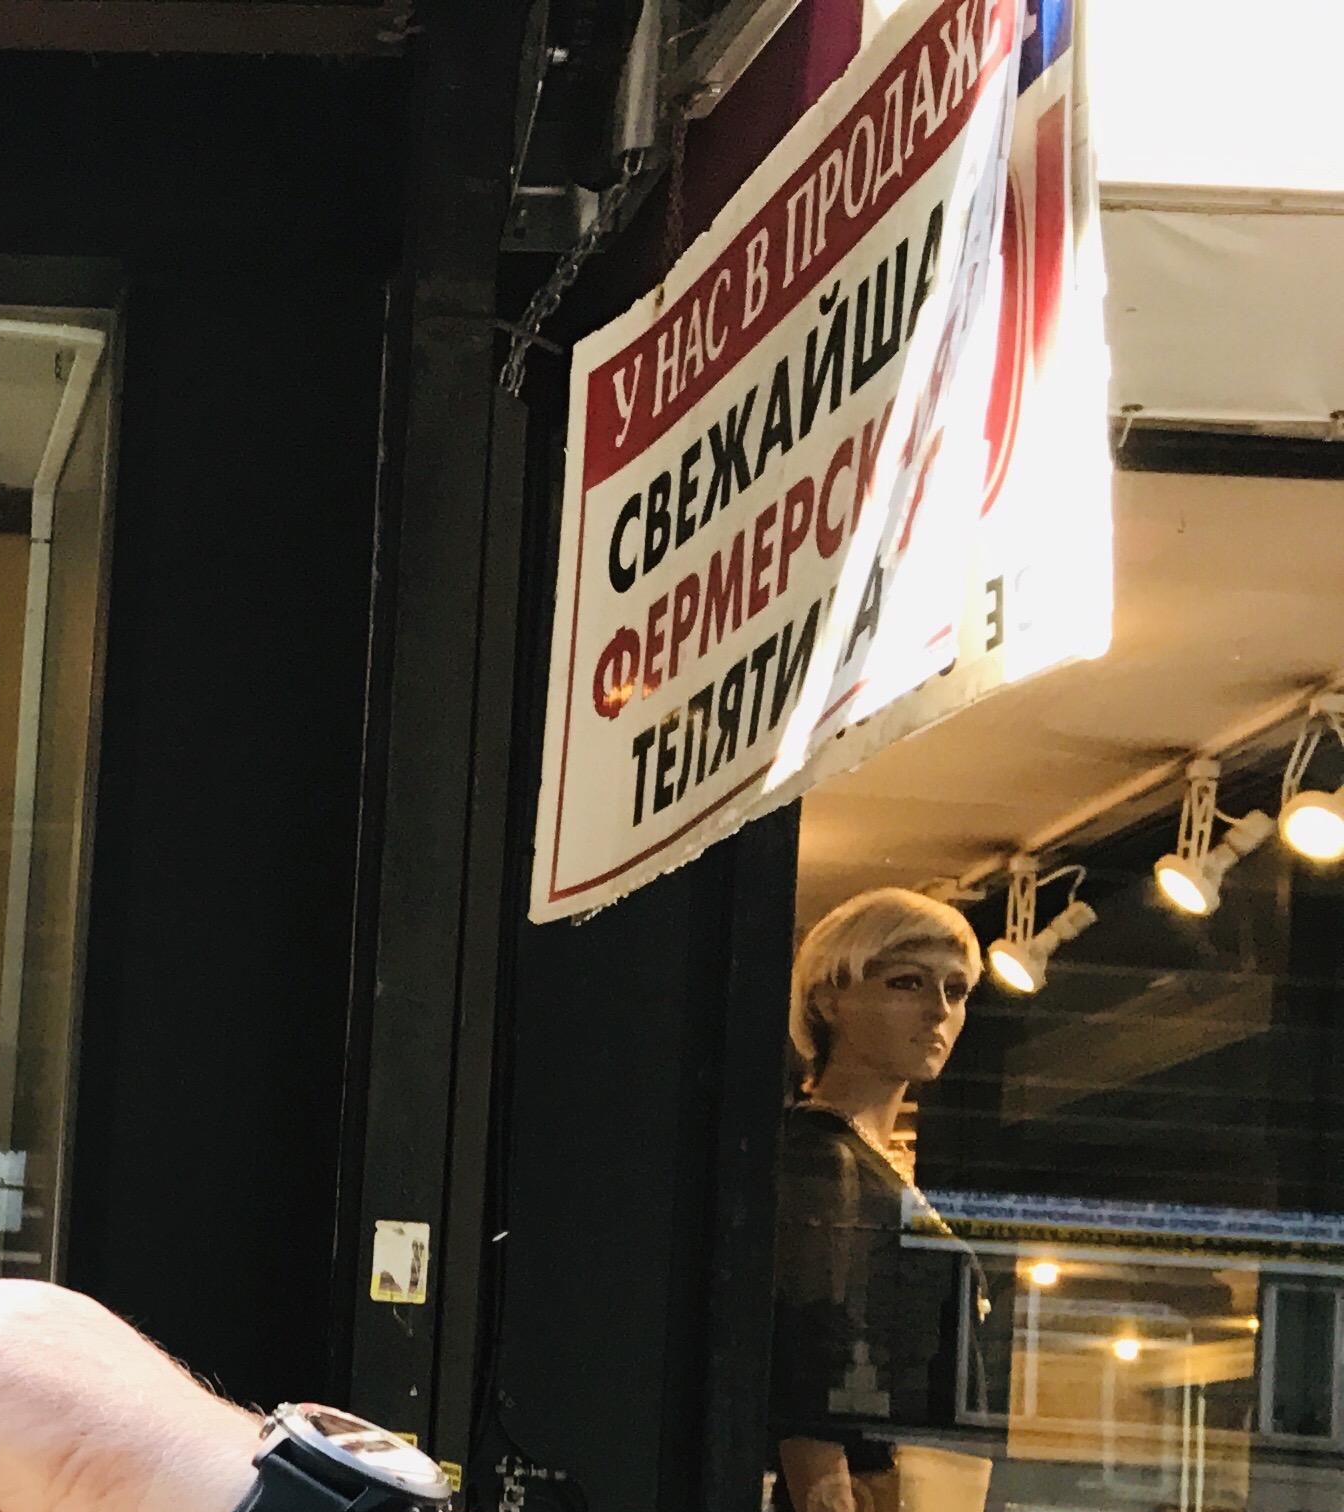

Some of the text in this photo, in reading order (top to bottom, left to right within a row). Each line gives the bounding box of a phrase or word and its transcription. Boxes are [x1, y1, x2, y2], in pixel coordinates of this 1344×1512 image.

[608, 200, 946, 594] СВЕЖАЙША
[612, 353, 643, 447] У
[652, 268, 732, 419] НАС
[741, 227, 769, 330] В
[592, 397, 944, 720] ФЕРМЕРСК
